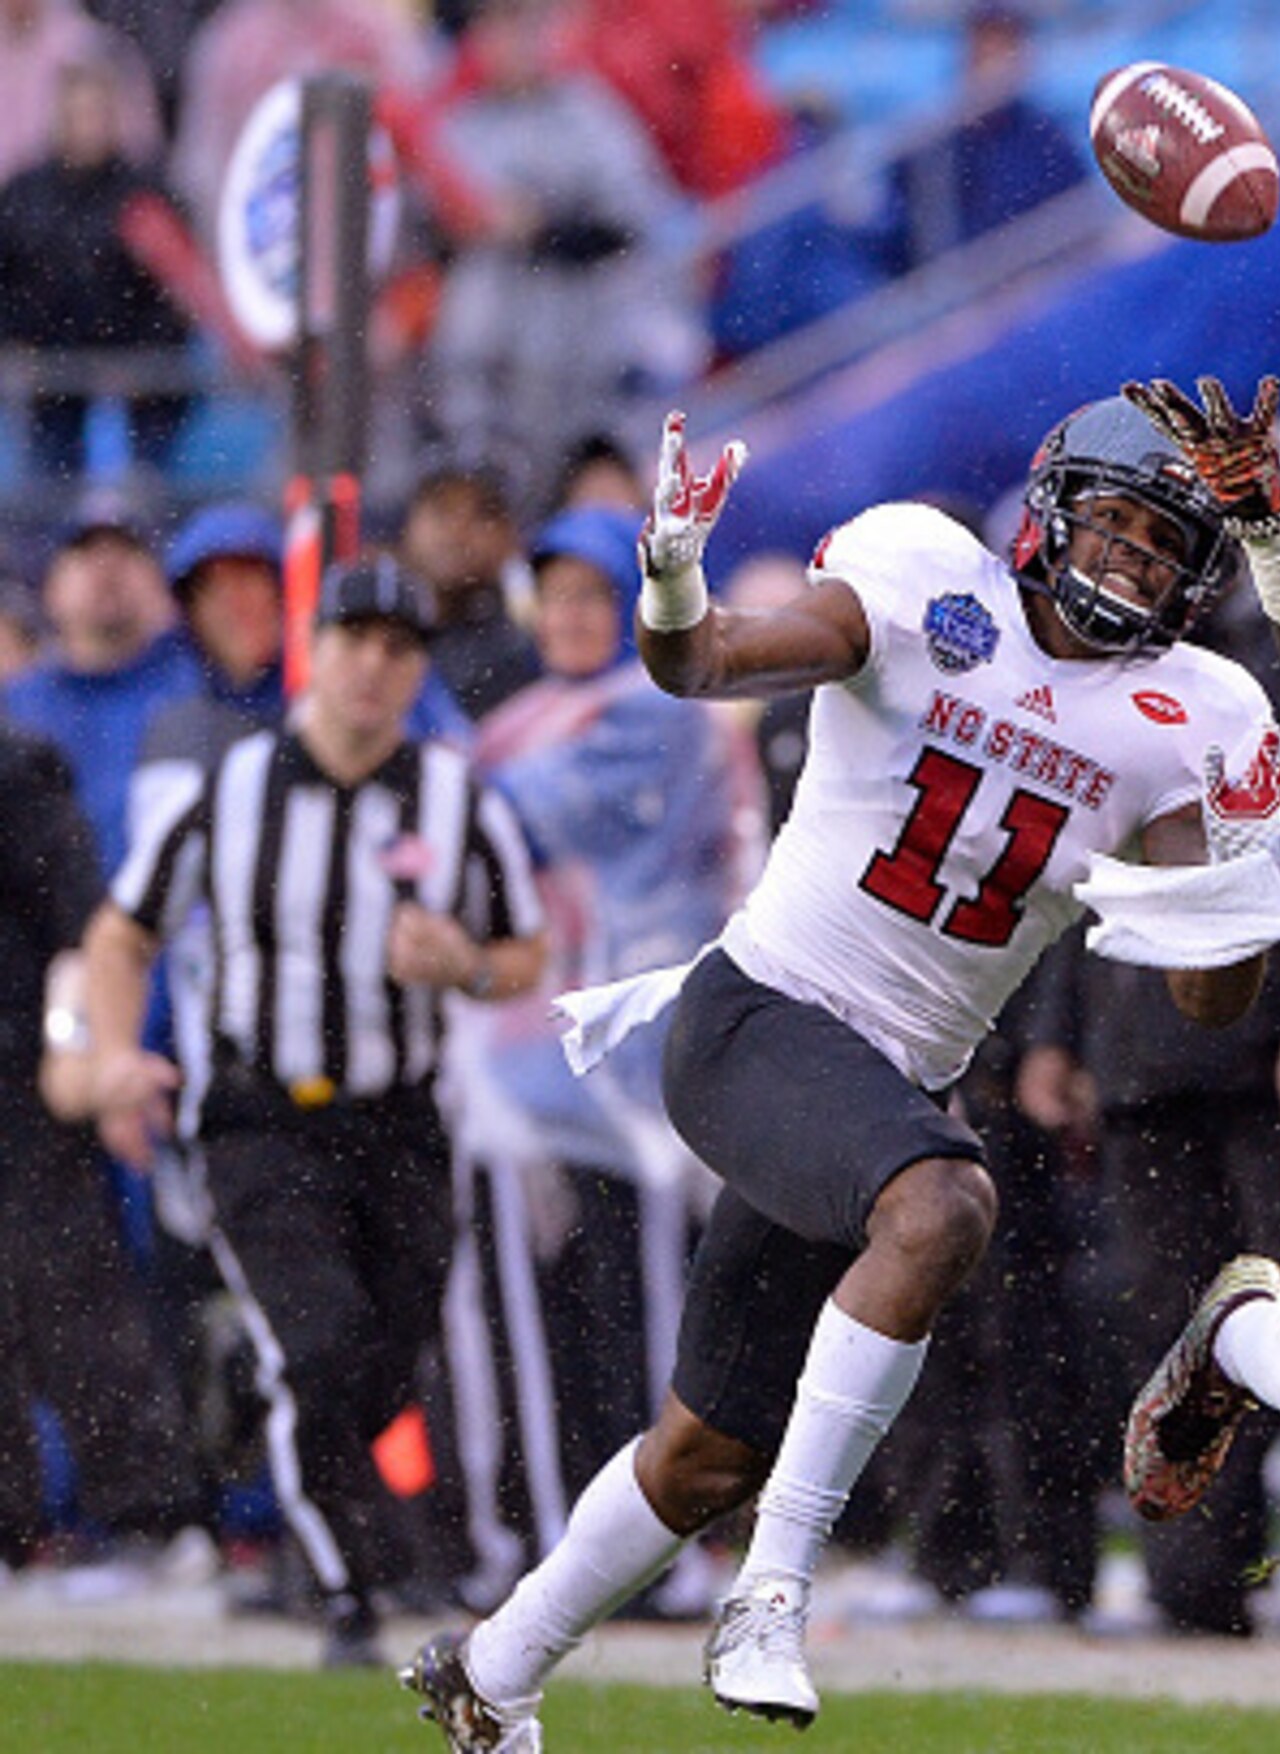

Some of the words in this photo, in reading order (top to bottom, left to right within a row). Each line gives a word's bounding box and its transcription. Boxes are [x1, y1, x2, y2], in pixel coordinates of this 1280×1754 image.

[918, 689, 987, 747] NC
[983, 718, 1118, 811] STATE
[858, 744, 1071, 949] 11
